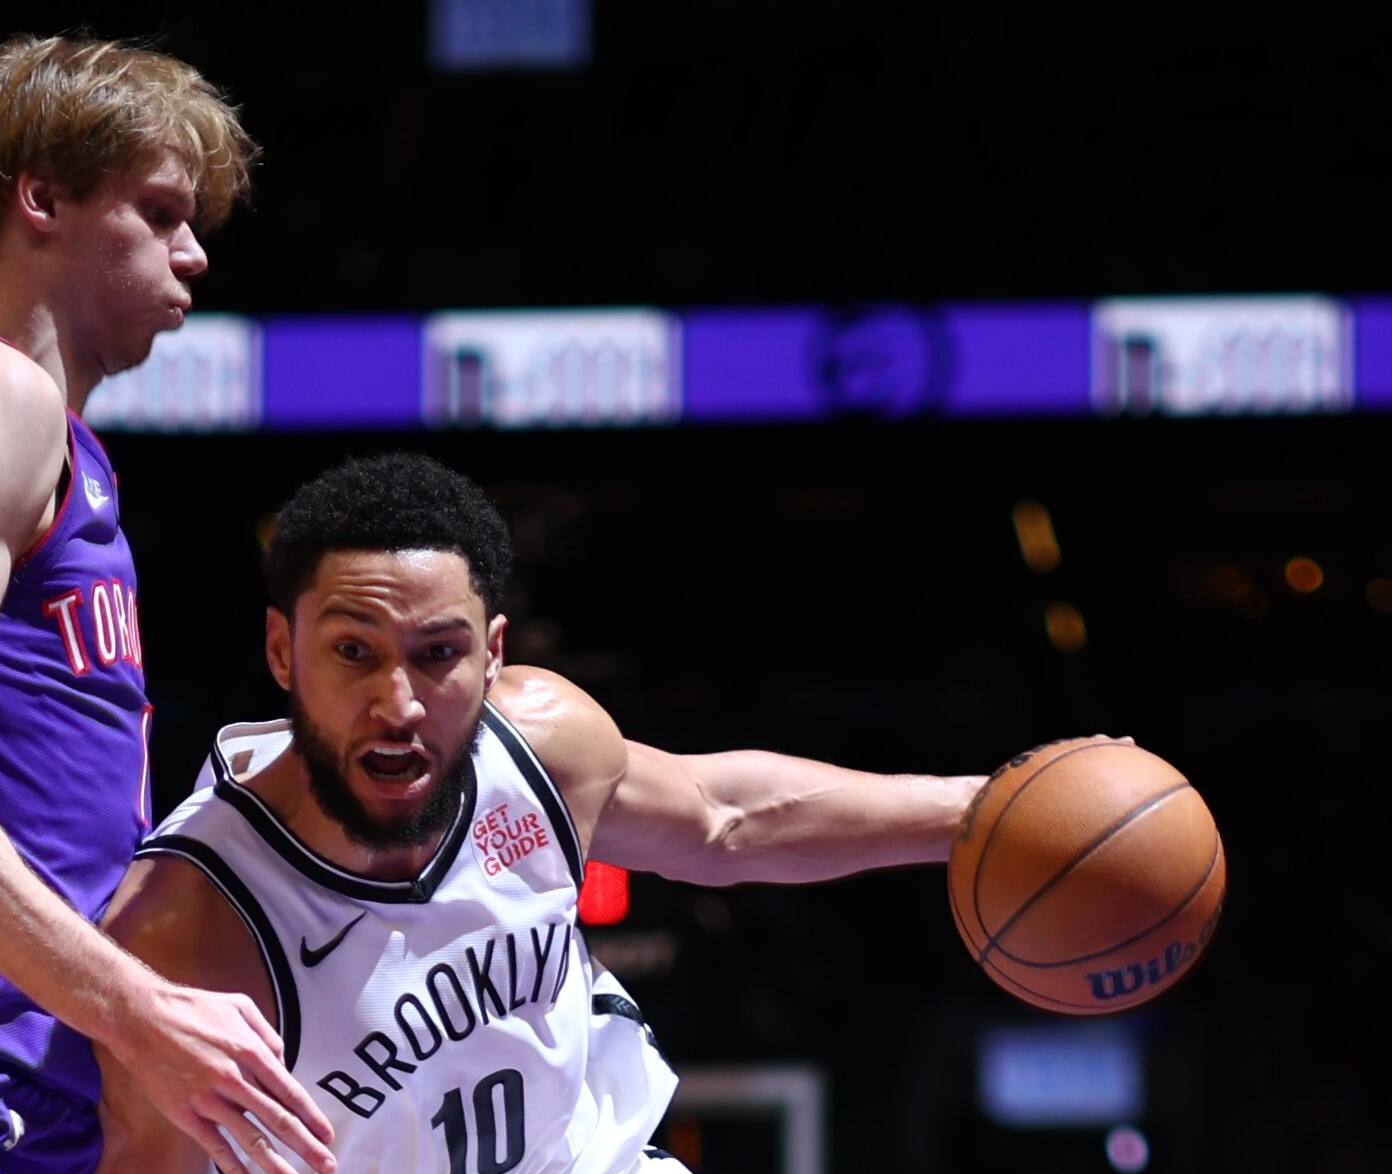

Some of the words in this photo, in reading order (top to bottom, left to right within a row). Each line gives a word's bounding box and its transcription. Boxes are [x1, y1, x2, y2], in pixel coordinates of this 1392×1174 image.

[473, 804, 507, 839] GET
[476, 813, 540, 856] YOUR
[484, 828, 549, 876] GUIDE
